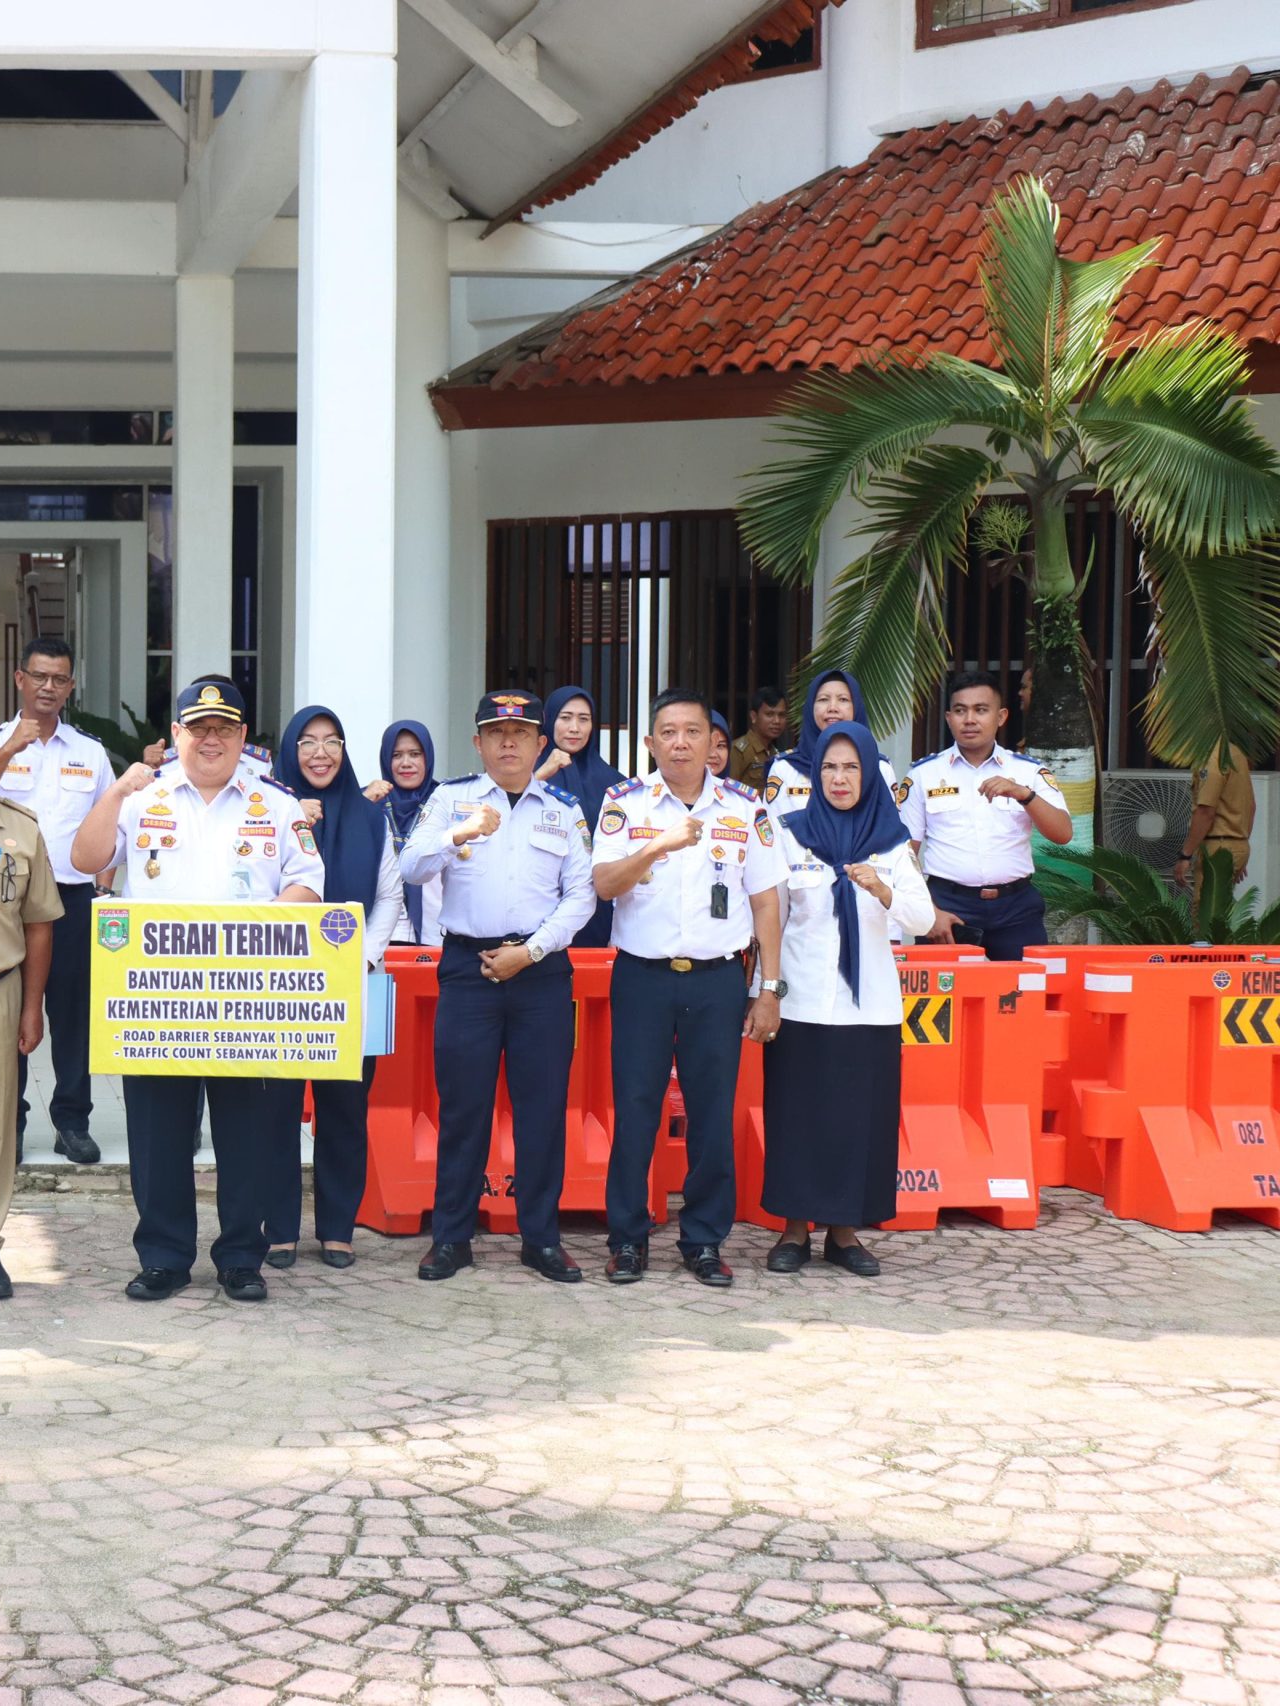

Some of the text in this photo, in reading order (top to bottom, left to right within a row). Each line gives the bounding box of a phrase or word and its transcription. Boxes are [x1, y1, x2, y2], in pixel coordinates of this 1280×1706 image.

[931, 787, 956, 795] RIZZA
[240, 828, 274, 836] DISHUB
[714, 830, 747, 842] DISHUB
[143, 922, 310, 956] SERAH TERIMA
[128, 970, 325, 992] BANTUAN TEKNIS FASKES
[1242, 971, 1280, 994] KEME
[107, 1000, 346, 1022] KEMENTERIAN PERHUBUNGAN
[123, 1030, 155, 1041] ROAD
[160, 1031, 210, 1042] BARRIER
[214, 1031, 276, 1043] SEBANYAK
[281, 1032, 302, 1043] 110
[306, 1033, 336, 1044] UNIT
[123, 1047, 168, 1058] TRAFFIC
[172, 1047, 212, 1058] COUNT
[216, 1048, 278, 1059] SEBANYAK
[283, 1049, 304, 1060] 176
[308, 1049, 337, 1060] UNIT
[1238, 1123, 1264, 1144] 082
[1253, 1175, 1280, 1196] TA
